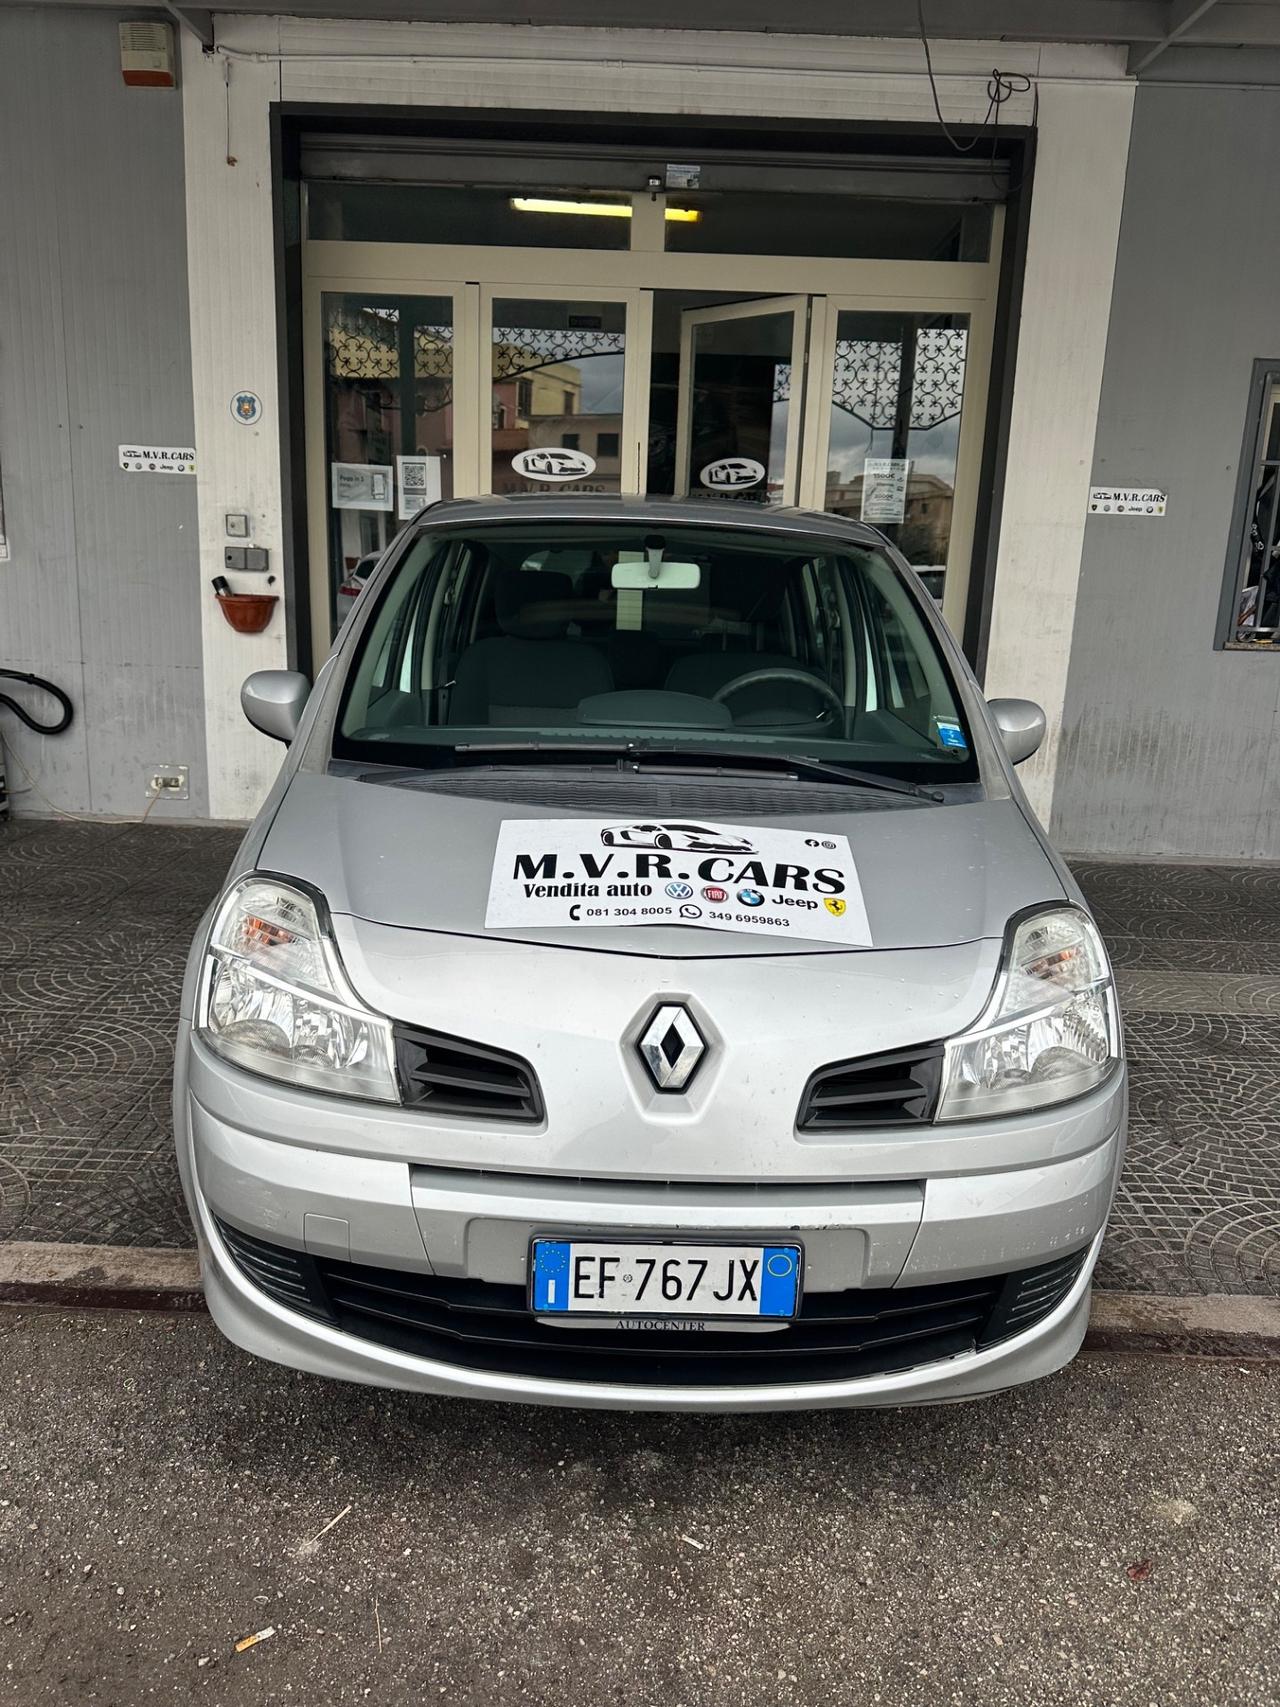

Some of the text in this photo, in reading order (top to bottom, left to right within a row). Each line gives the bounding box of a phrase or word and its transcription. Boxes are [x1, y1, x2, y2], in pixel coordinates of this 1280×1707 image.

[697, 857, 846, 895] CARS
[523, 882, 653, 898] Vendita auto
[707, 888, 724, 900] FIAT
[771, 894, 819, 911] Jeep
[586, 906, 673, 917] 081 304 8005
[708, 911, 791, 928] 349 6959863
[572, 1256, 760, 1302] EF 767 JX
[615, 1320, 706, 1333] AUTOCENTER
